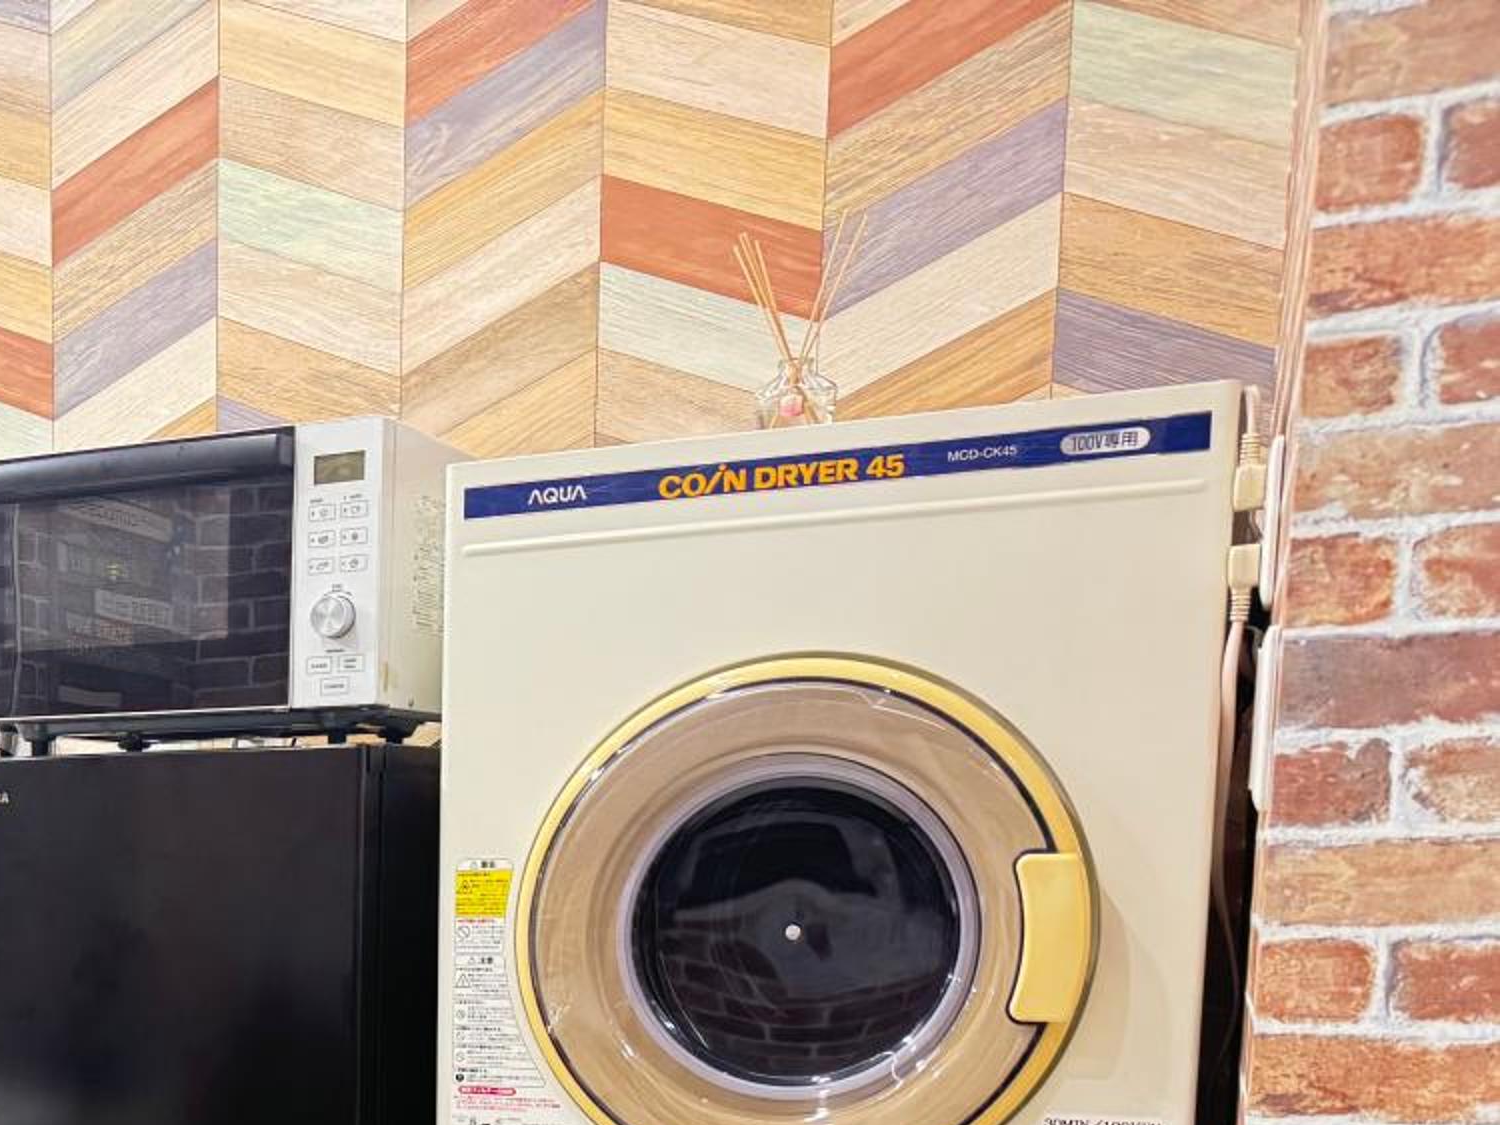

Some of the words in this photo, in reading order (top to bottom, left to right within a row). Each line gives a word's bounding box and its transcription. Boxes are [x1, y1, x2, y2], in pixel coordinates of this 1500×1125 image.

[947, 445, 1018, 463] MCD-CK45
[658, 463, 750, 500] COIN
[753, 457, 859, 492] DRYER
[866, 454, 904, 480] 45
[528, 484, 588, 506] AQUA
